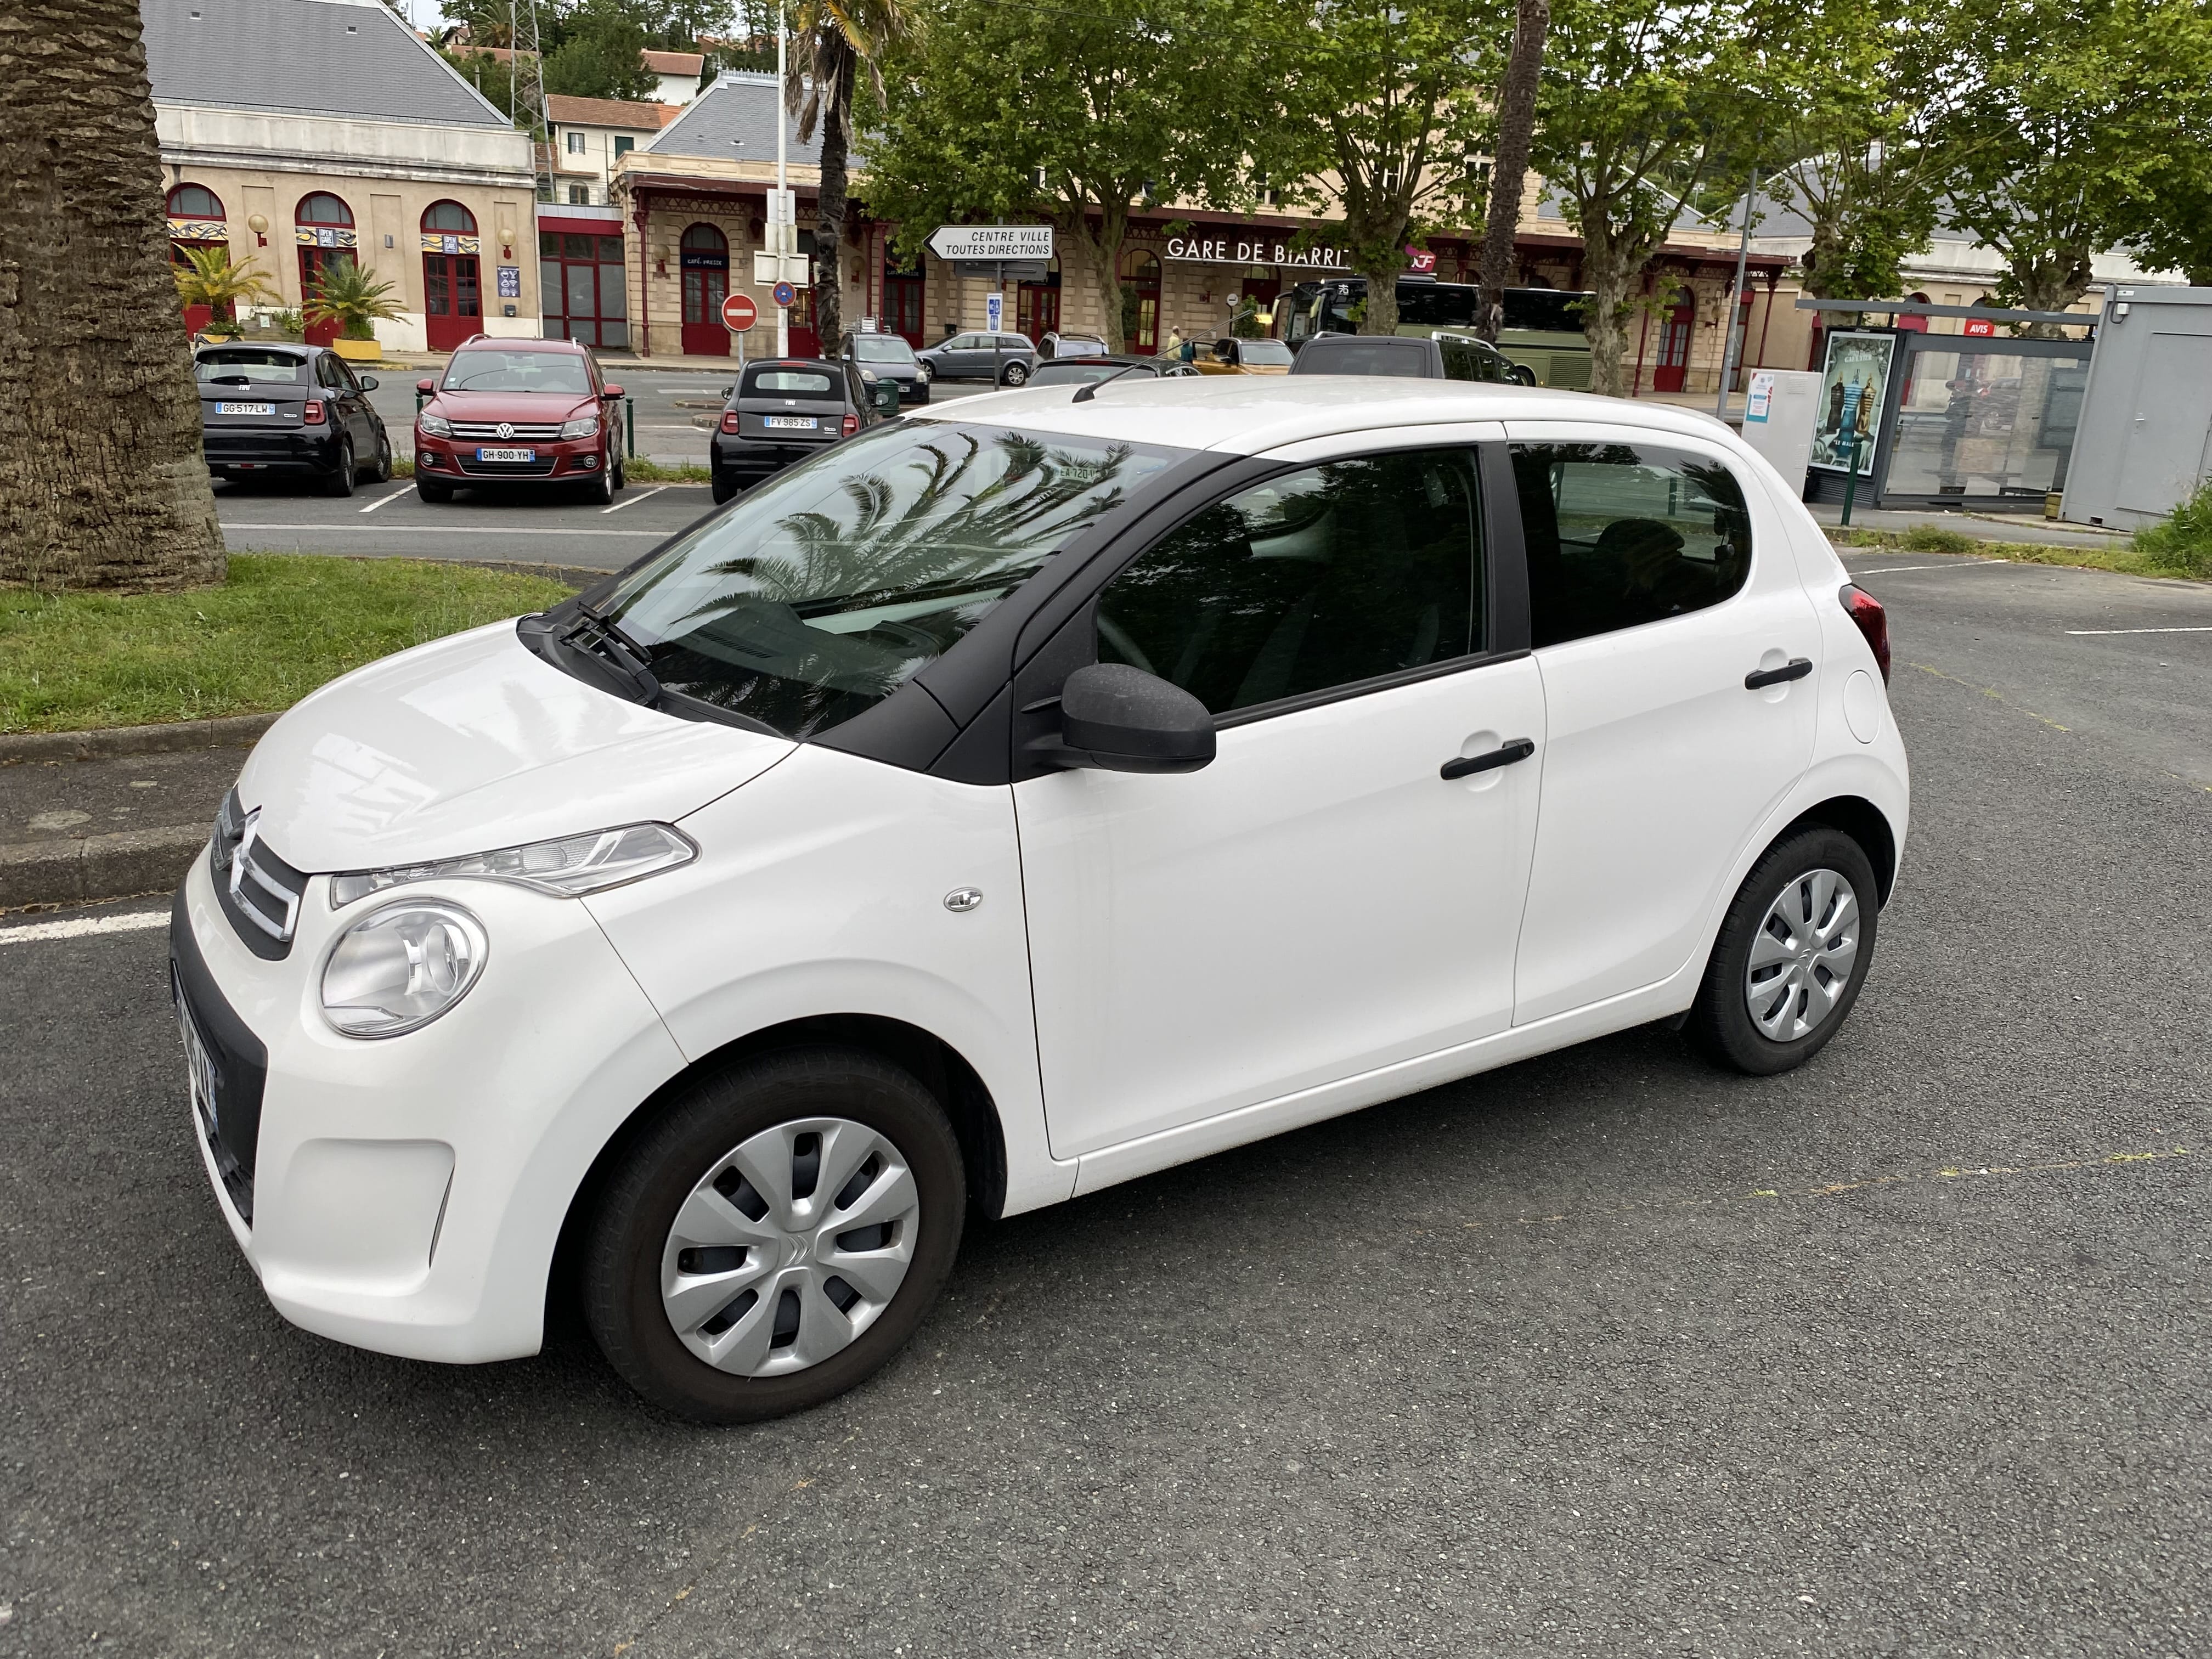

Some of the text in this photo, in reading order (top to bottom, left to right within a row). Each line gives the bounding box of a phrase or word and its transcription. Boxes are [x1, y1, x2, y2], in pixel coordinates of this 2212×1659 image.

[972, 232, 1049, 241] CENTRE VILLE
[946, 245, 1049, 255] TOUTES DIRECTIONS
[1167, 238, 1349, 267] GARE DE BIARRI
[1970, 324, 1988, 334] AVIS
[771, 418, 810, 426] FV-985-ZS
[483, 451, 528, 459] GH-900-YH
